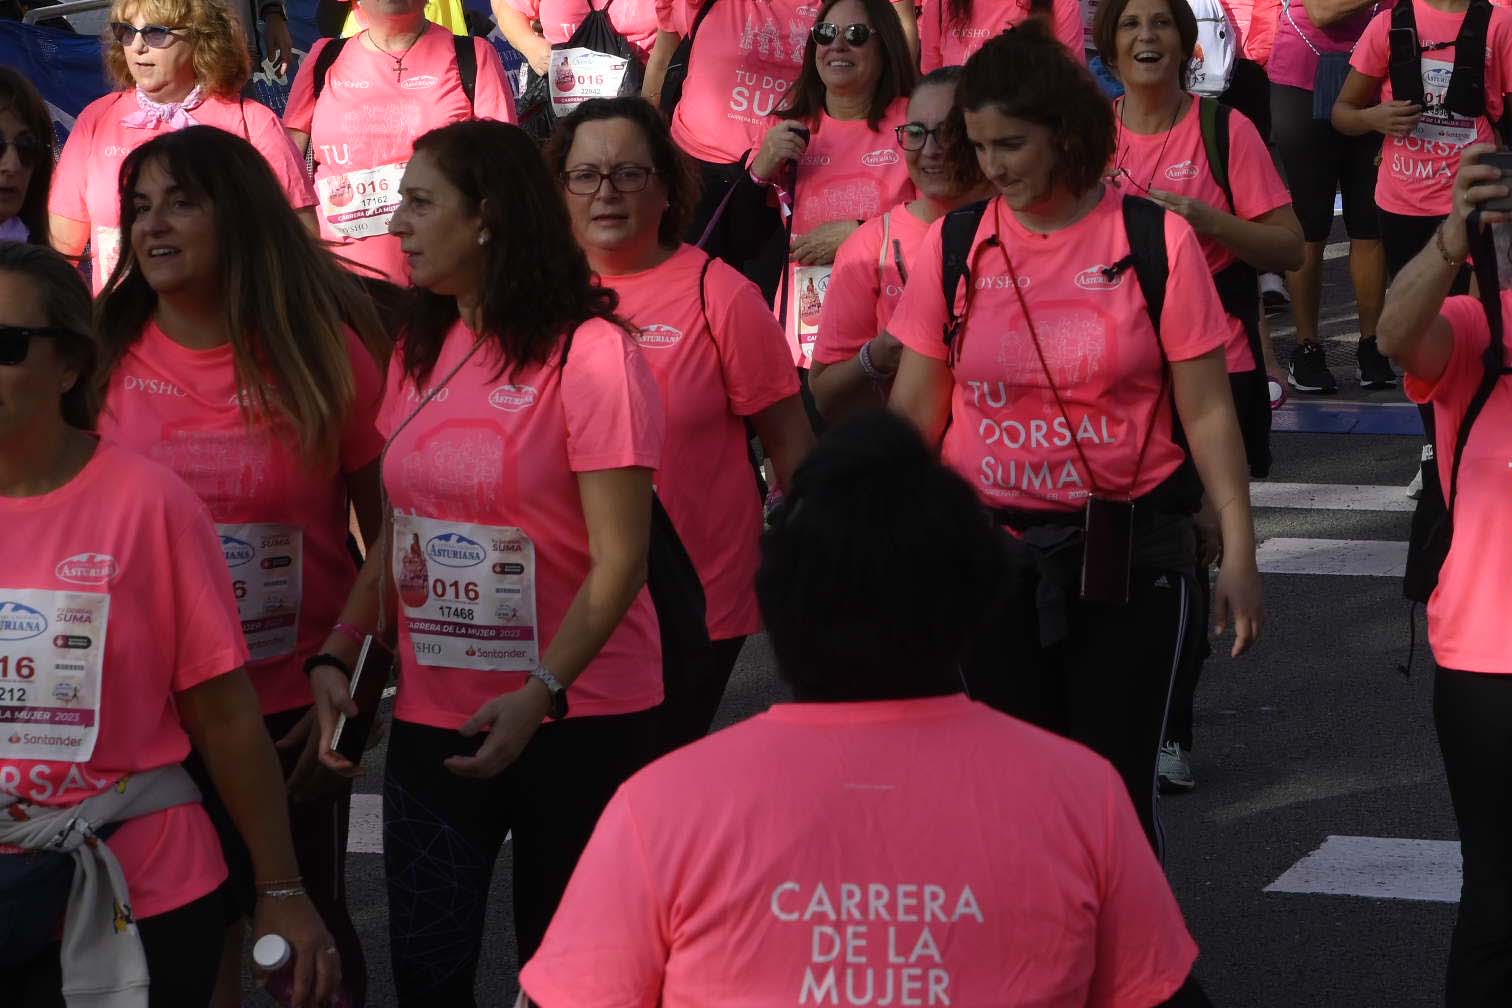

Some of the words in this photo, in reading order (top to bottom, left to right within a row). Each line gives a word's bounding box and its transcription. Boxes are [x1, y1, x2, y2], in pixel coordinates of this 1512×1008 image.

[735, 69, 756, 87] TU
[320, 143, 350, 165] TU
[1392, 152, 1453, 178] SUMA
[356, 178, 390, 195] 016
[361, 195, 388, 208] 17162
[967, 380, 1007, 408] TU
[978, 414, 1117, 449] DORSAL
[980, 456, 1083, 490] SUMA
[429, 544, 481, 561] ASTURIANA
[492, 543, 523, 553] SUMA
[432, 579, 480, 602] 016
[56, 613, 92, 624] SUMA
[438, 605, 475, 620] 17468
[442, 624, 455, 633] DE
[456, 625, 467, 633] LA
[468, 626, 496, 637] MUJER
[477, 648, 527, 659] Santander
[14, 710, 51, 721] MUJER
[55, 711, 81, 721] 2023
[23, 733, 83, 747] Santander
[770, 881, 985, 923] CARRERA
[812, 925, 868, 964] DE
[888, 926, 943, 964] LA
[798, 967, 952, 1006] MUJER
